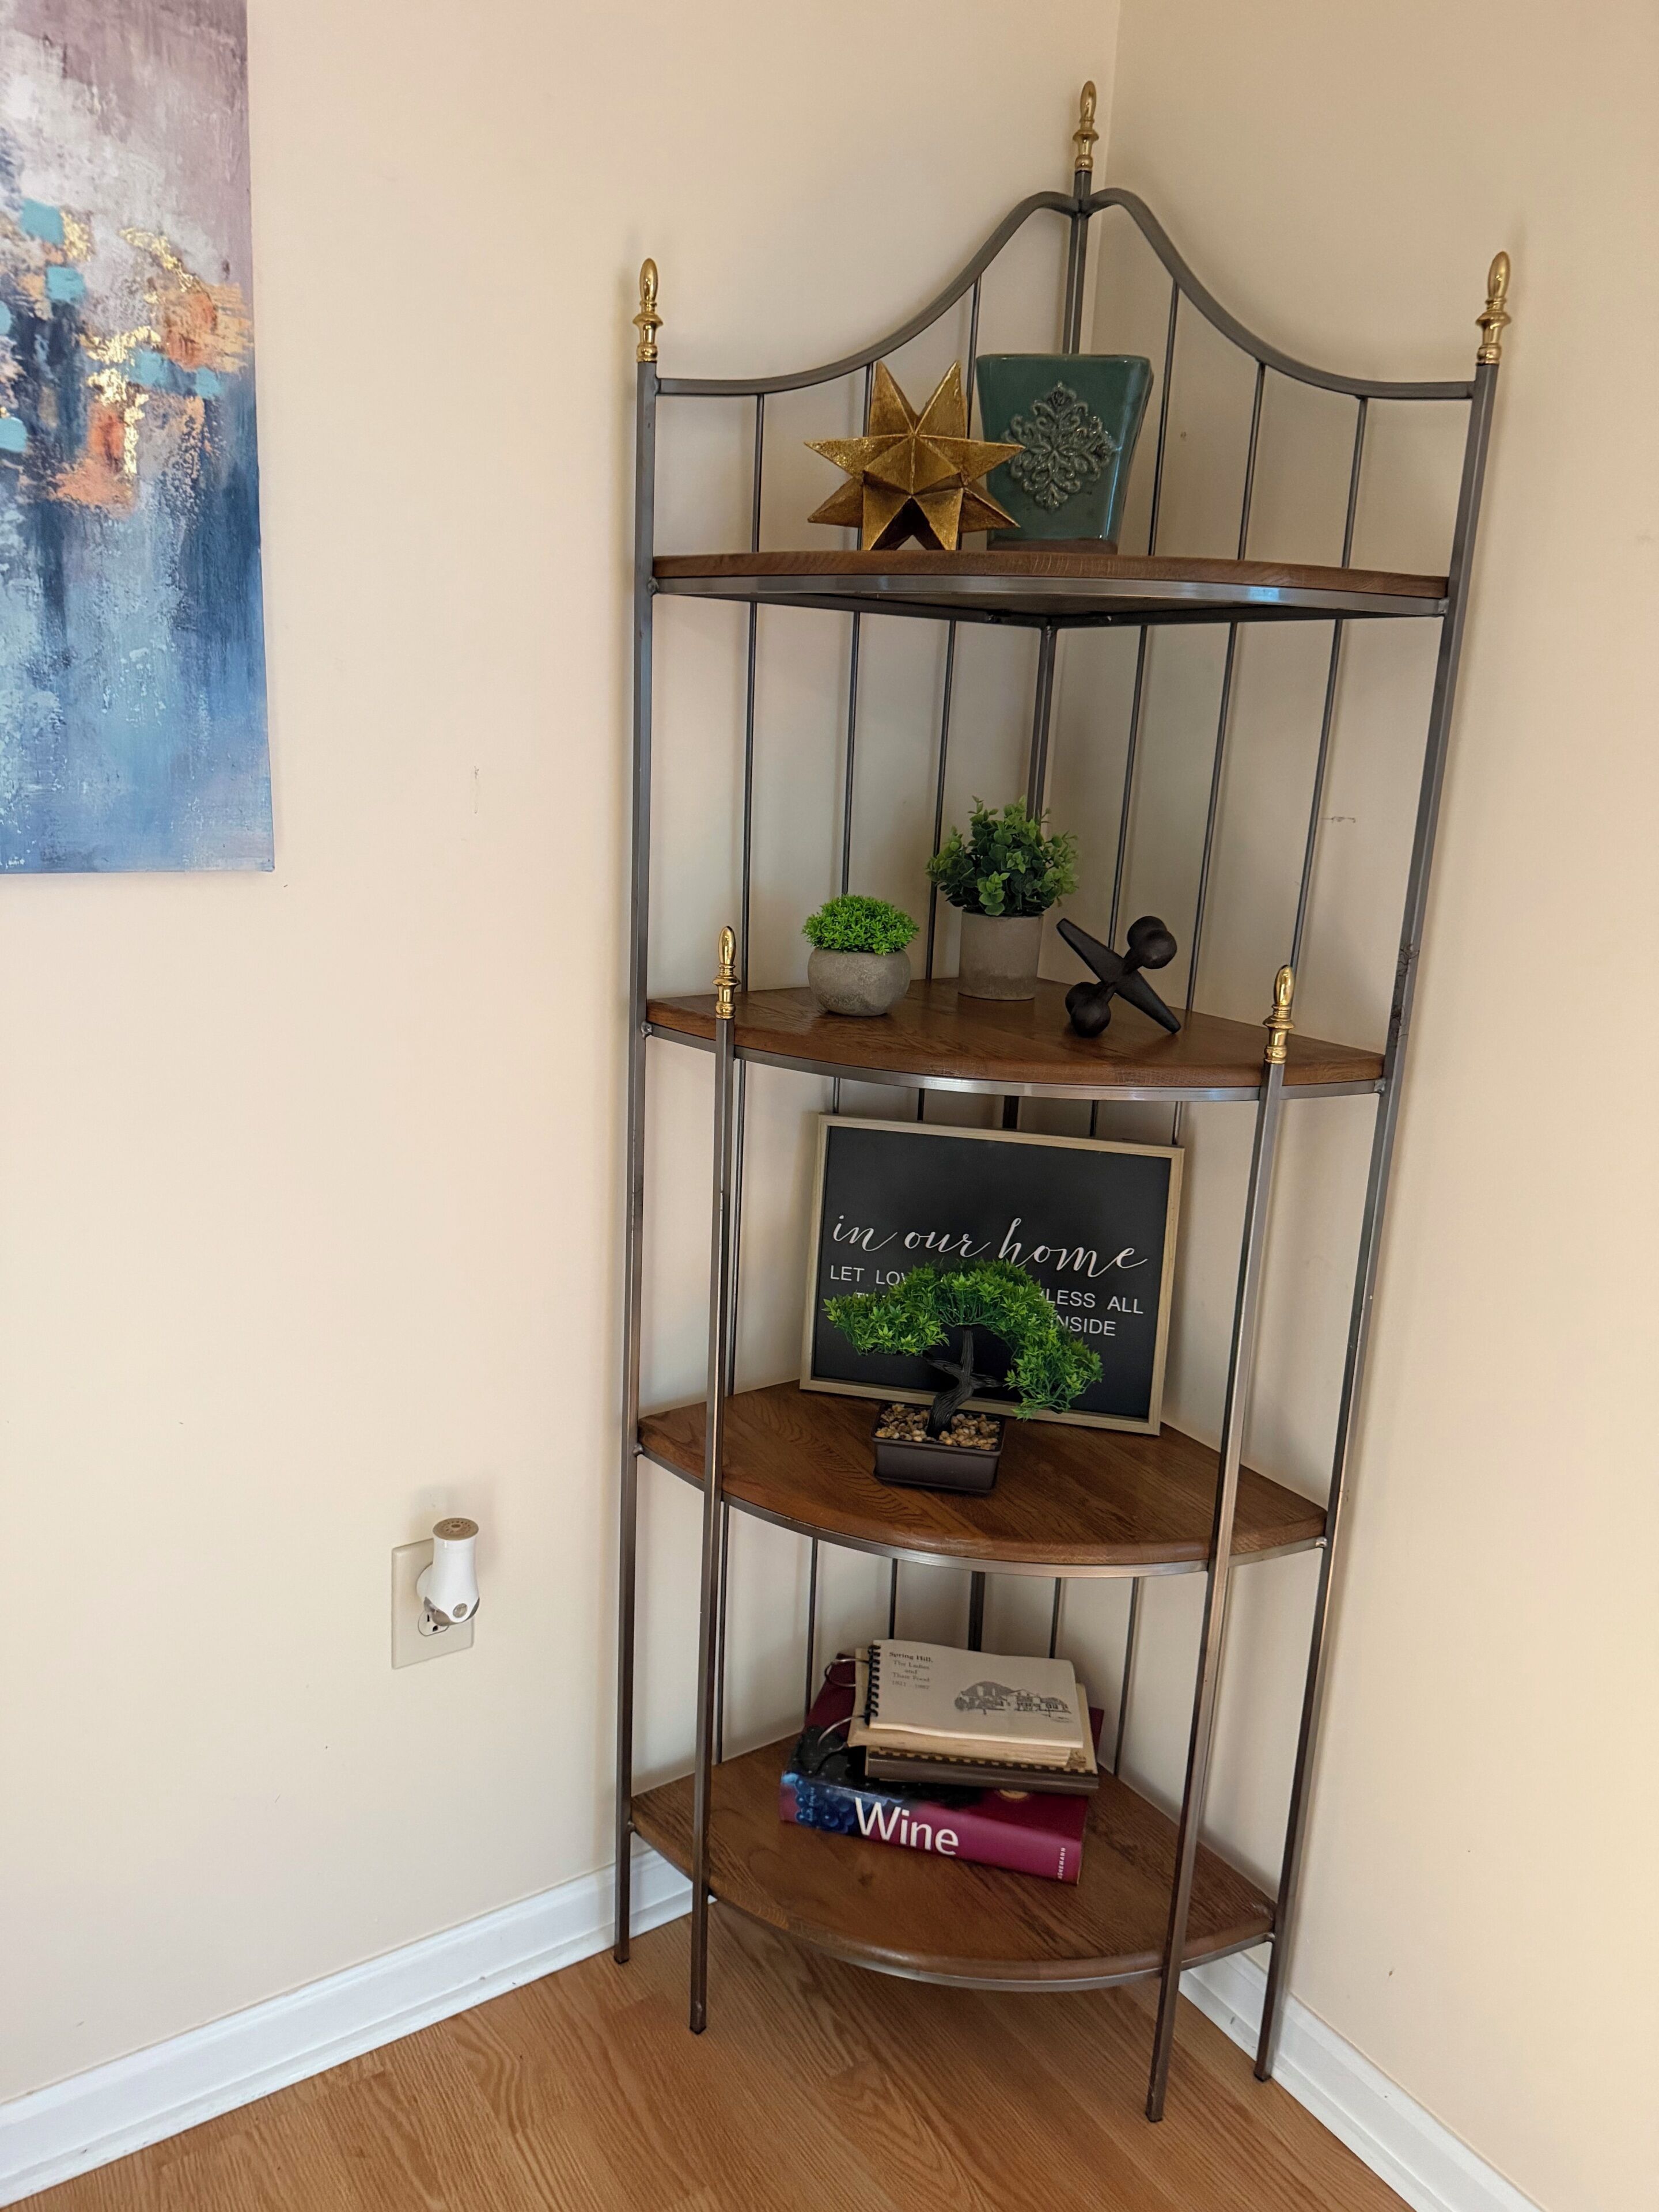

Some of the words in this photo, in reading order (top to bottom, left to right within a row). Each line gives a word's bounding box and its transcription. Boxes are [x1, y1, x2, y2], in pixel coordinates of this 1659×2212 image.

[833, 1215, 898, 1252] in
[904, 1231, 991, 1257] our
[998, 1217, 1148, 1278] home
[830, 1265, 865, 1282] LET
[876, 1270, 906, 1286] LO
[1040, 1288, 1096, 1308] LESS
[1107, 1296, 1144, 1315] ALL
[1056, 1315, 1116, 1336] NSIDE
[889, 1652, 914, 1661] Spring
[855, 1797, 959, 1856] Wine
